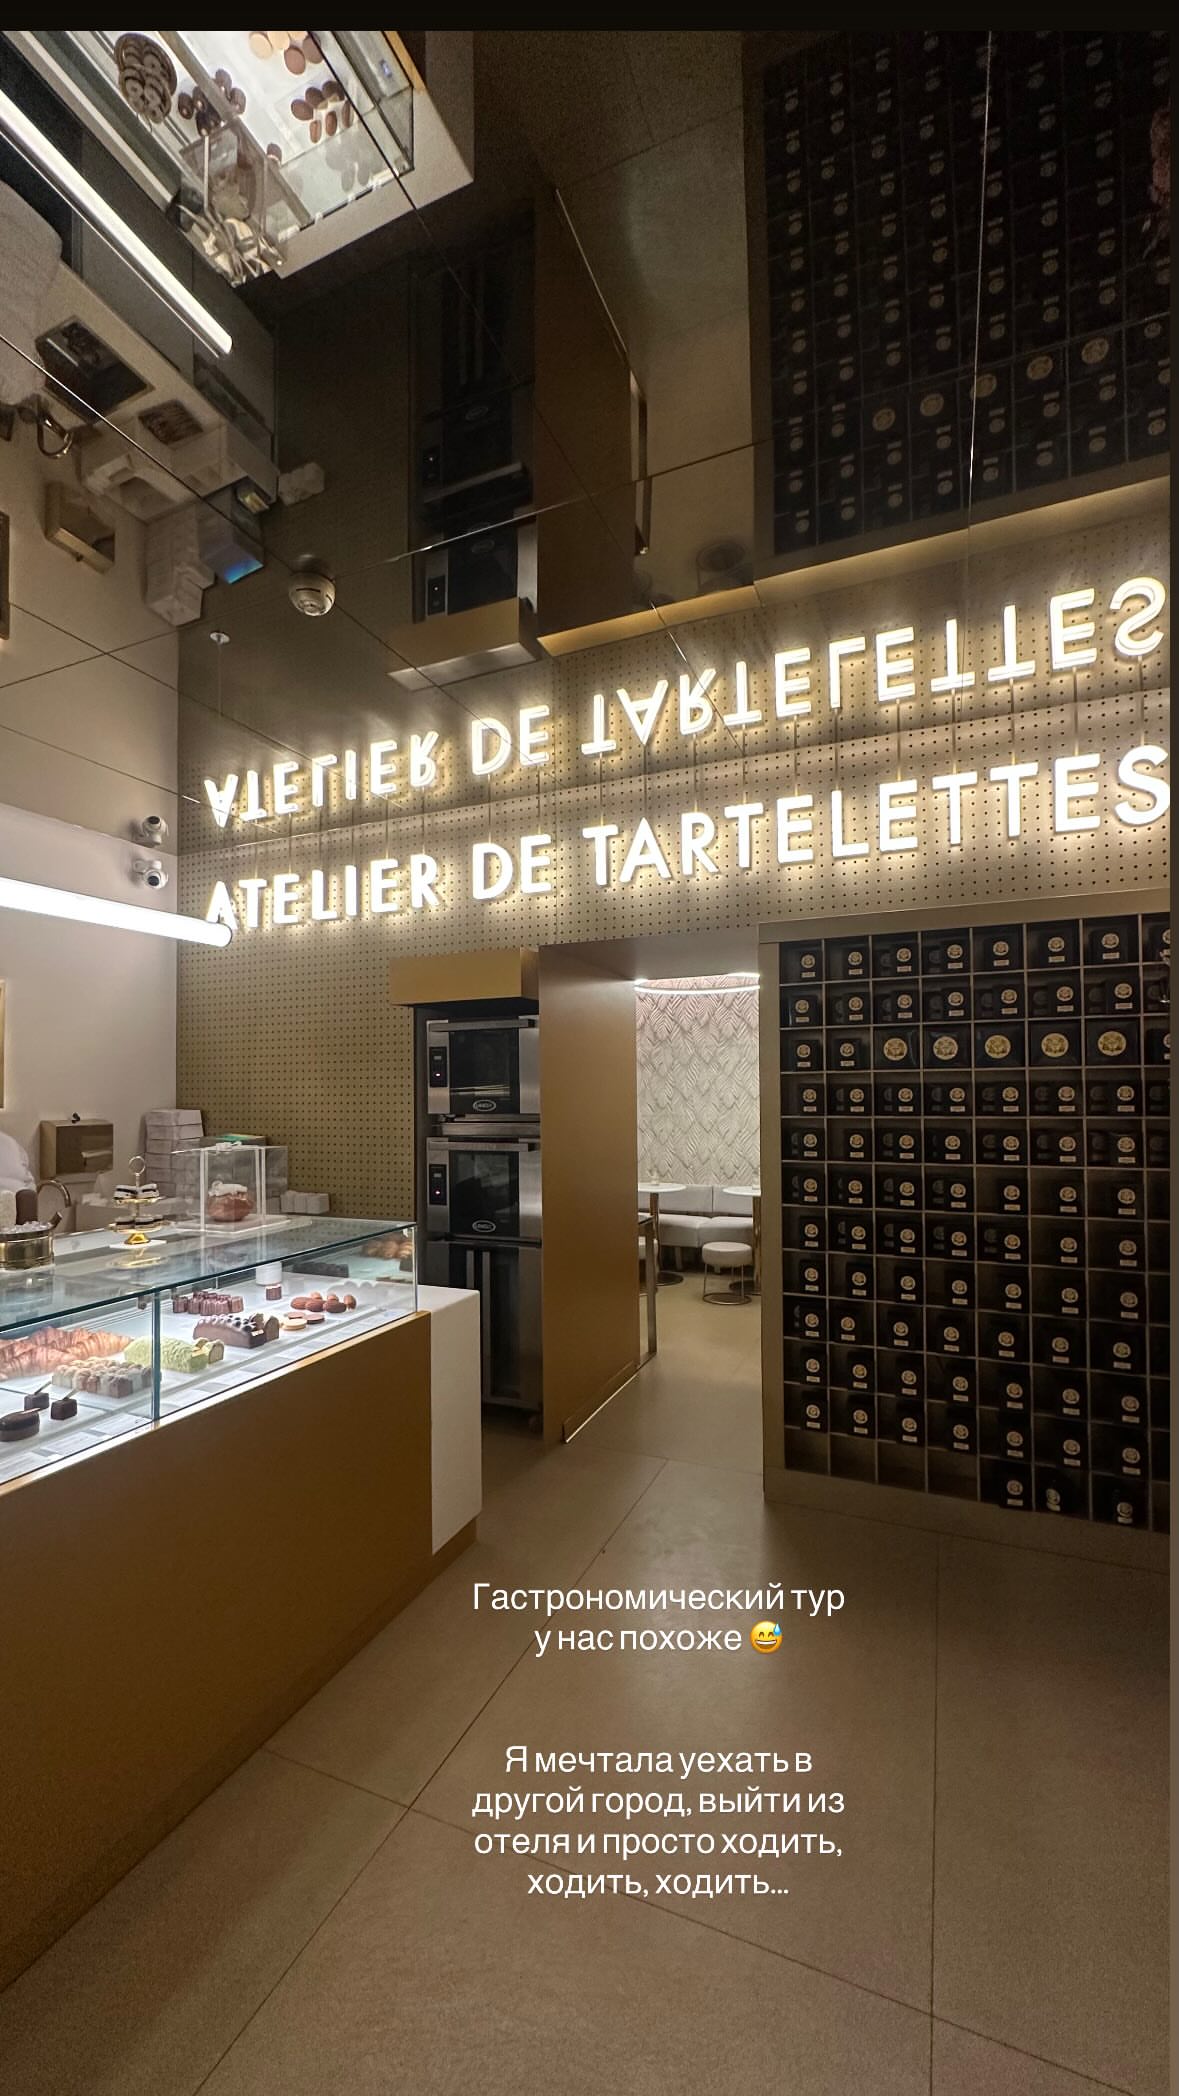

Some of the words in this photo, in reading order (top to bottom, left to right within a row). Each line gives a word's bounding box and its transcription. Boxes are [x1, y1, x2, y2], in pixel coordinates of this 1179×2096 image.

[205, 853, 441, 932] ATELIER
[472, 833, 552, 901] DE
[581, 743, 1171, 887] TARTELETTES
